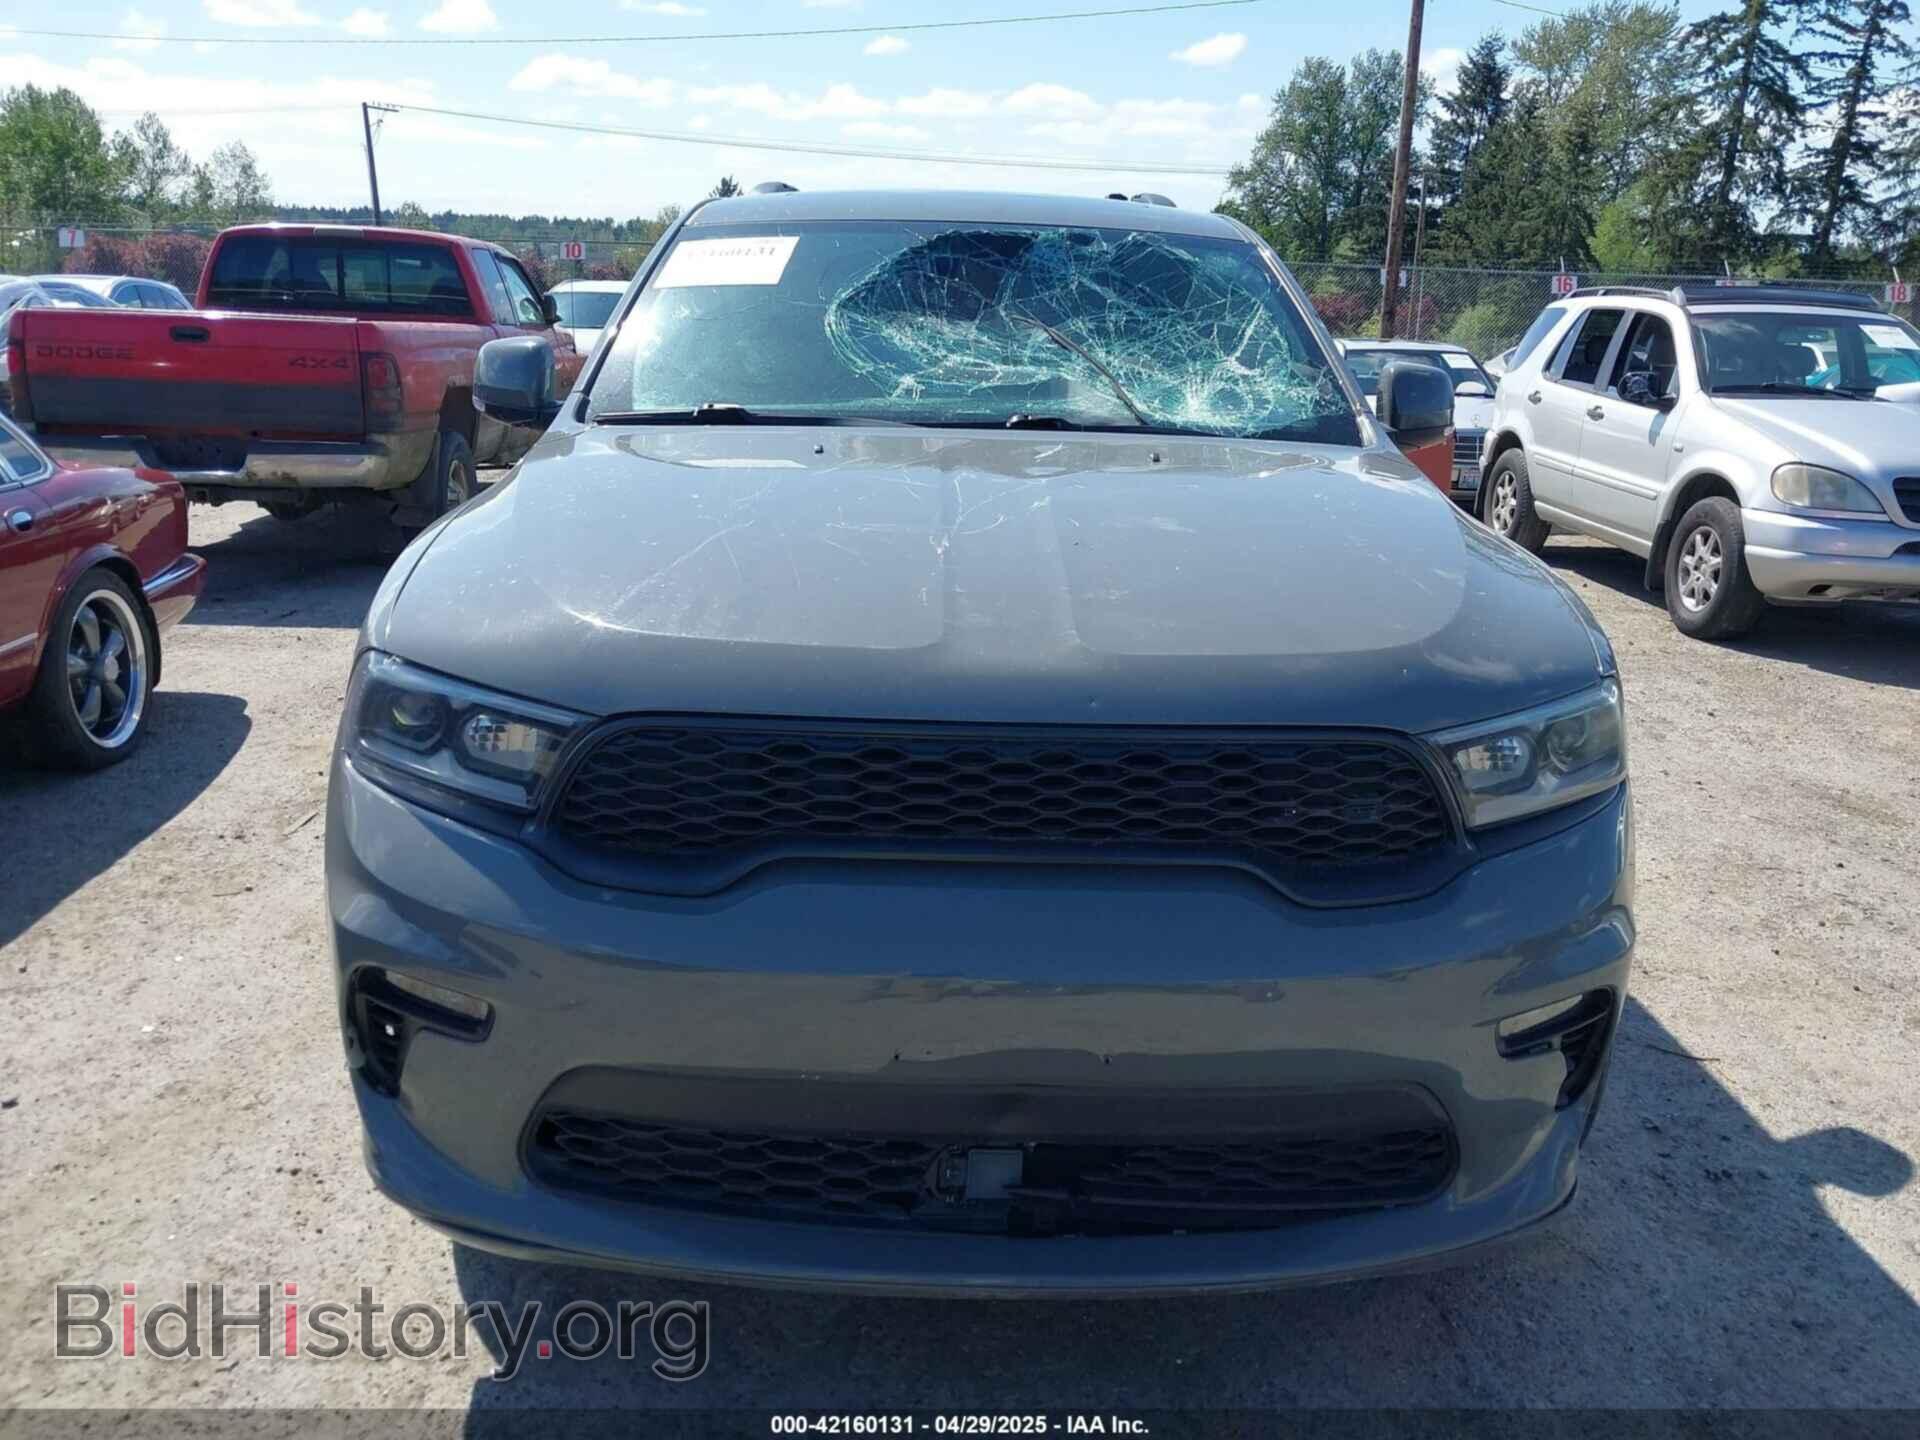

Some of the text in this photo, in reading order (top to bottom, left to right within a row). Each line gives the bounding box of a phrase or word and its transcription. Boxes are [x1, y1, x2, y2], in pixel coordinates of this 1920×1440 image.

[67, 229, 77, 247] 7
[563, 243, 582, 258] 10
[1555, 276, 1573, 292] 16
[1890, 284, 1906, 301] 18
[36, 344, 136, 360] DODGE
